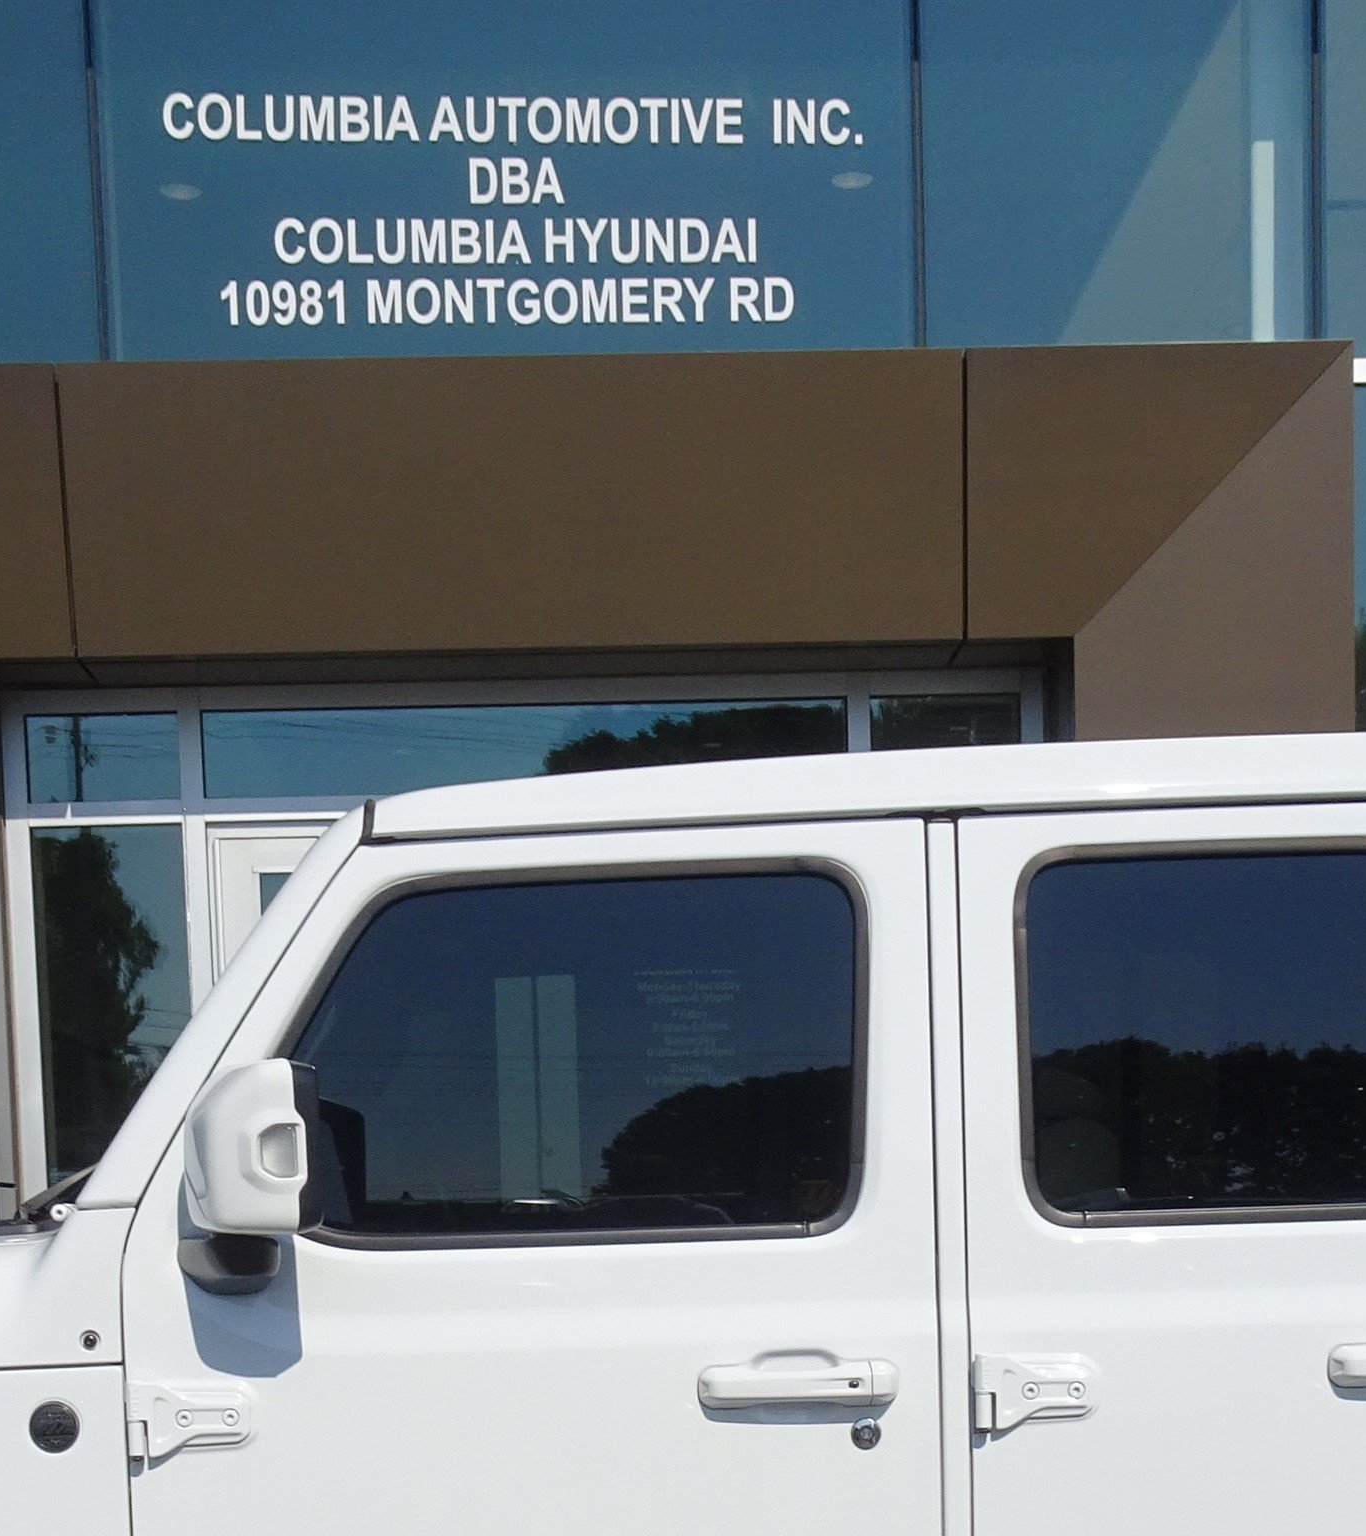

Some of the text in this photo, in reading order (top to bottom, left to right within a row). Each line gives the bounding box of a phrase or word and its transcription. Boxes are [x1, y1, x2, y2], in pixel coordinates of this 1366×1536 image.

[162, 92, 864, 145] COLUMBIA AUTOMOTIVE INC.
[468, 157, 565, 204] DBA
[274, 217, 758, 264] COLUMBIA HYUNDAI
[220, 276, 796, 326] 10981 MONTGOMERY RD
